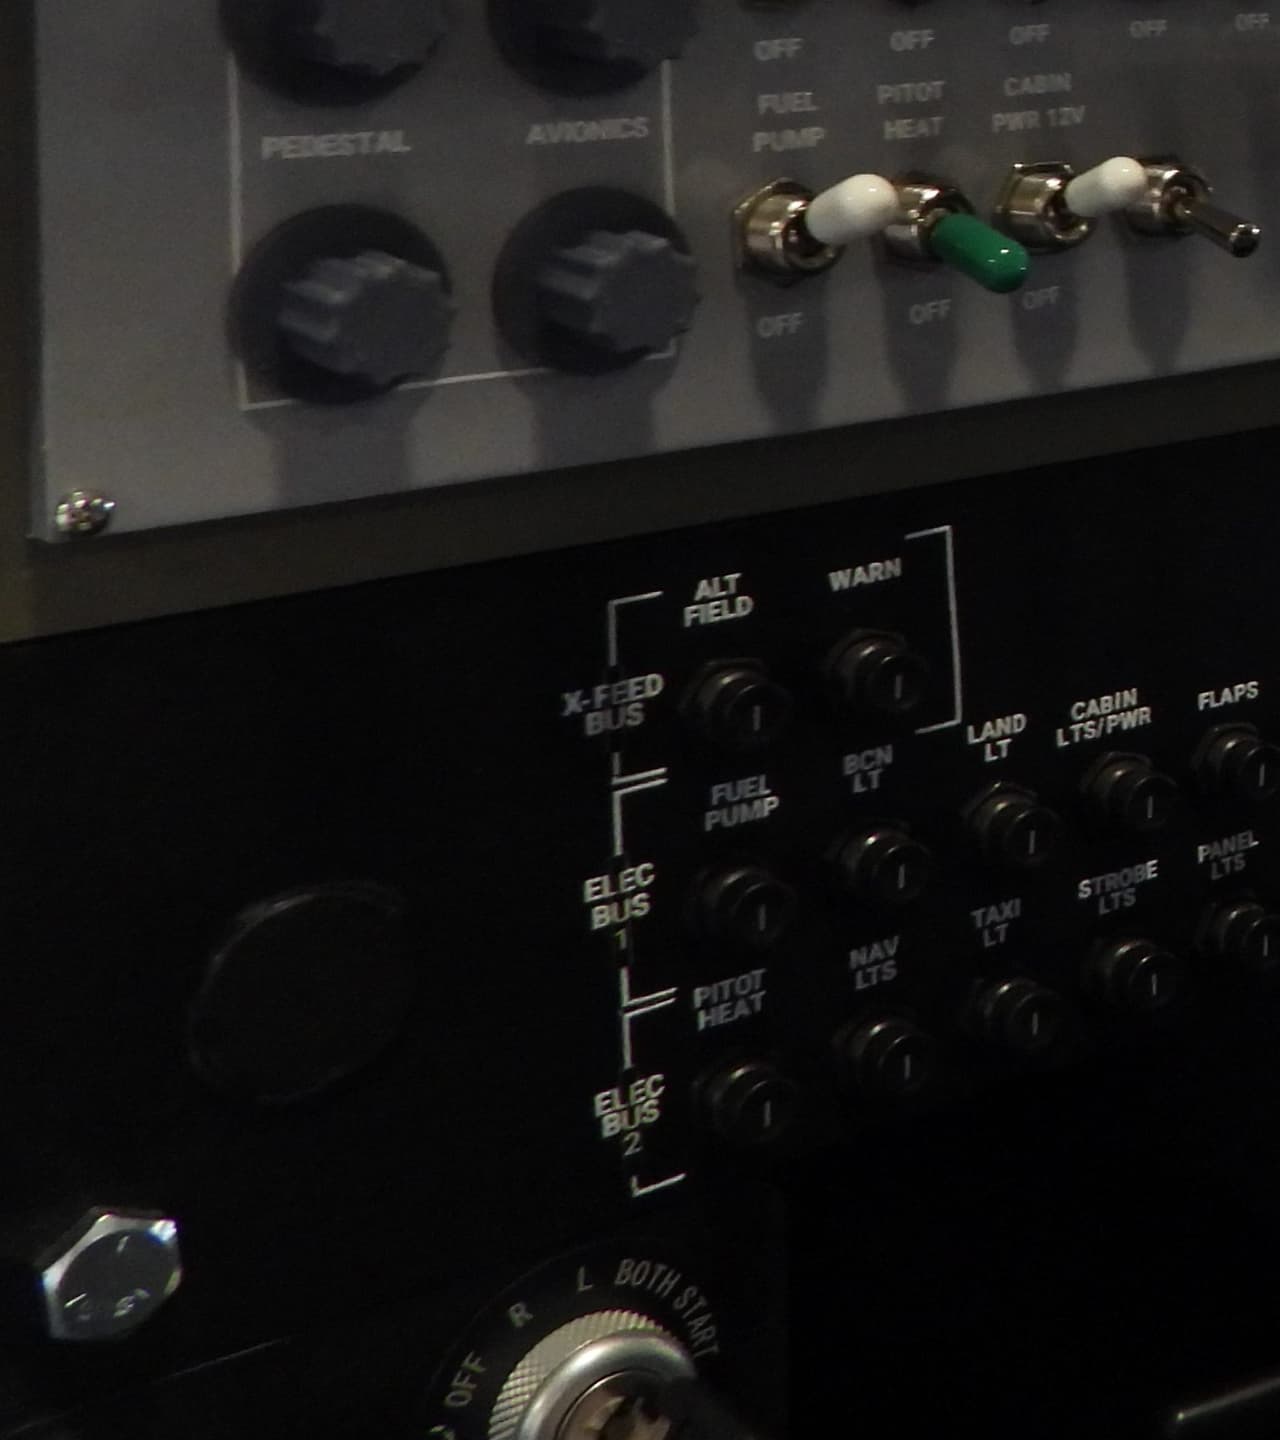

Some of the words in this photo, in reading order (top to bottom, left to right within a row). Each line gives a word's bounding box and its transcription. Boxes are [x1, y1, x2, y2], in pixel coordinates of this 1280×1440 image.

[1008, 23, 1052, 46] OFF
[1128, 18, 1169, 40] OFF
[1234, 12, 1271, 33] OFF
[753, 37, 803, 62] OFF
[888, 28, 936, 53] OFF
[876, 80, 946, 105] PITOT
[1003, 73, 1073, 97] CABIN
[757, 91, 820, 115] FUEL
[525, 117, 650, 146] AVIONICS
[884, 116, 944, 141] HEAT
[991, 110, 1041, 133] PWR
[1045, 105, 1087, 128] 12V
[261, 131, 413, 160] PEDESTAL
[752, 126, 826, 152] PUMP
[908, 299, 952, 325] OFF
[1022, 286, 1061, 310] OFF
[756, 313, 803, 338] OFF
[693, 572, 744, 601] ALT
[827, 558, 902, 592] WARN
[683, 595, 755, 628] FIELD
[560, 672, 665, 717] X-FEED
[1070, 688, 1138, 721] CABIN
[1197, 681, 1260, 711] FLAPS
[584, 702, 646, 737] BUS
[967, 713, 1028, 745] LAND
[1055, 707, 1152, 749] LTS/PWR
[842, 744, 894, 777] BCN
[984, 739, 1013, 762] LT
[711, 773, 773, 806] FUEL
[852, 770, 884, 794] LT
[704, 795, 780, 832] PUMP
[1198, 829, 1260, 863] PANEL
[1077, 859, 1159, 900] STROBE
[1210, 853, 1247, 881] LTS
[583, 862, 656, 903] ELEC
[590, 892, 651, 931] BUS
[970, 897, 1022, 929] TAXI
[1099, 888, 1137, 916] LTS
[615, 930, 628, 949] 1
[982, 923, 1012, 948] LT
[848, 935, 900, 970] NAV
[693, 968, 767, 1009] PITOT
[854, 960, 899, 992] LTS
[697, 990, 767, 1031] HEAT
[593, 1073, 665, 1117] ELEC
[601, 1098, 661, 1140] BUS
[623, 1133, 644, 1156] 2
[576, 1265, 595, 1292] L
[507, 1301, 535, 1329] R
[614, 1258, 683, 1298] BOTH
[673, 1285, 721, 1361] START
[443, 1351, 486, 1408] OFF
